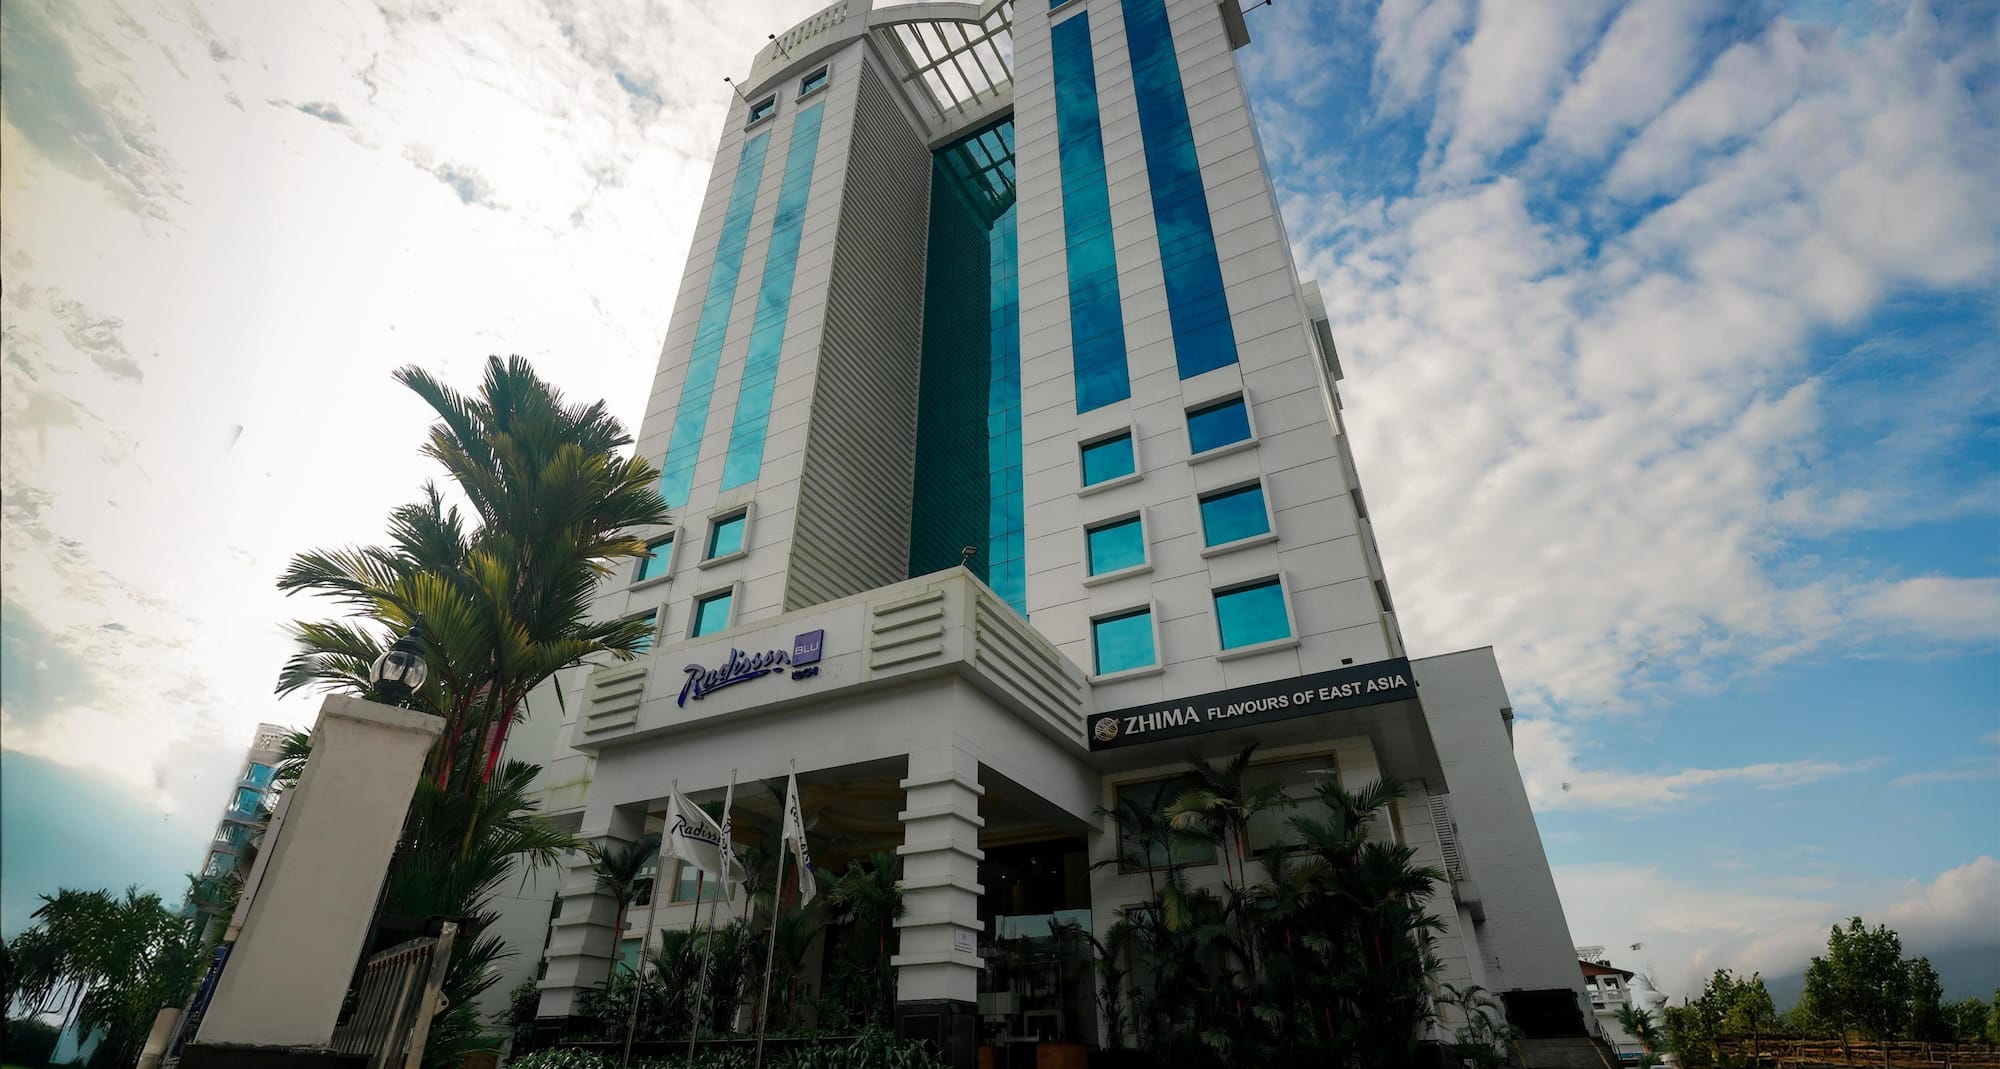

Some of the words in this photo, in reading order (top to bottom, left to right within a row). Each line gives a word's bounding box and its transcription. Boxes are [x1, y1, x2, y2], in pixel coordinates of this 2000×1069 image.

[677, 647, 791, 708] Radisson
[794, 641, 820, 656] BLU
[1123, 706, 1201, 735] ZHIMA
[1207, 694, 1290, 721] FLAVOURS
[1292, 690, 1315, 705] OF
[1318, 681, 1362, 701] EAST
[1366, 674, 1408, 693] ASIA
[671, 814, 722, 847] Radiss
